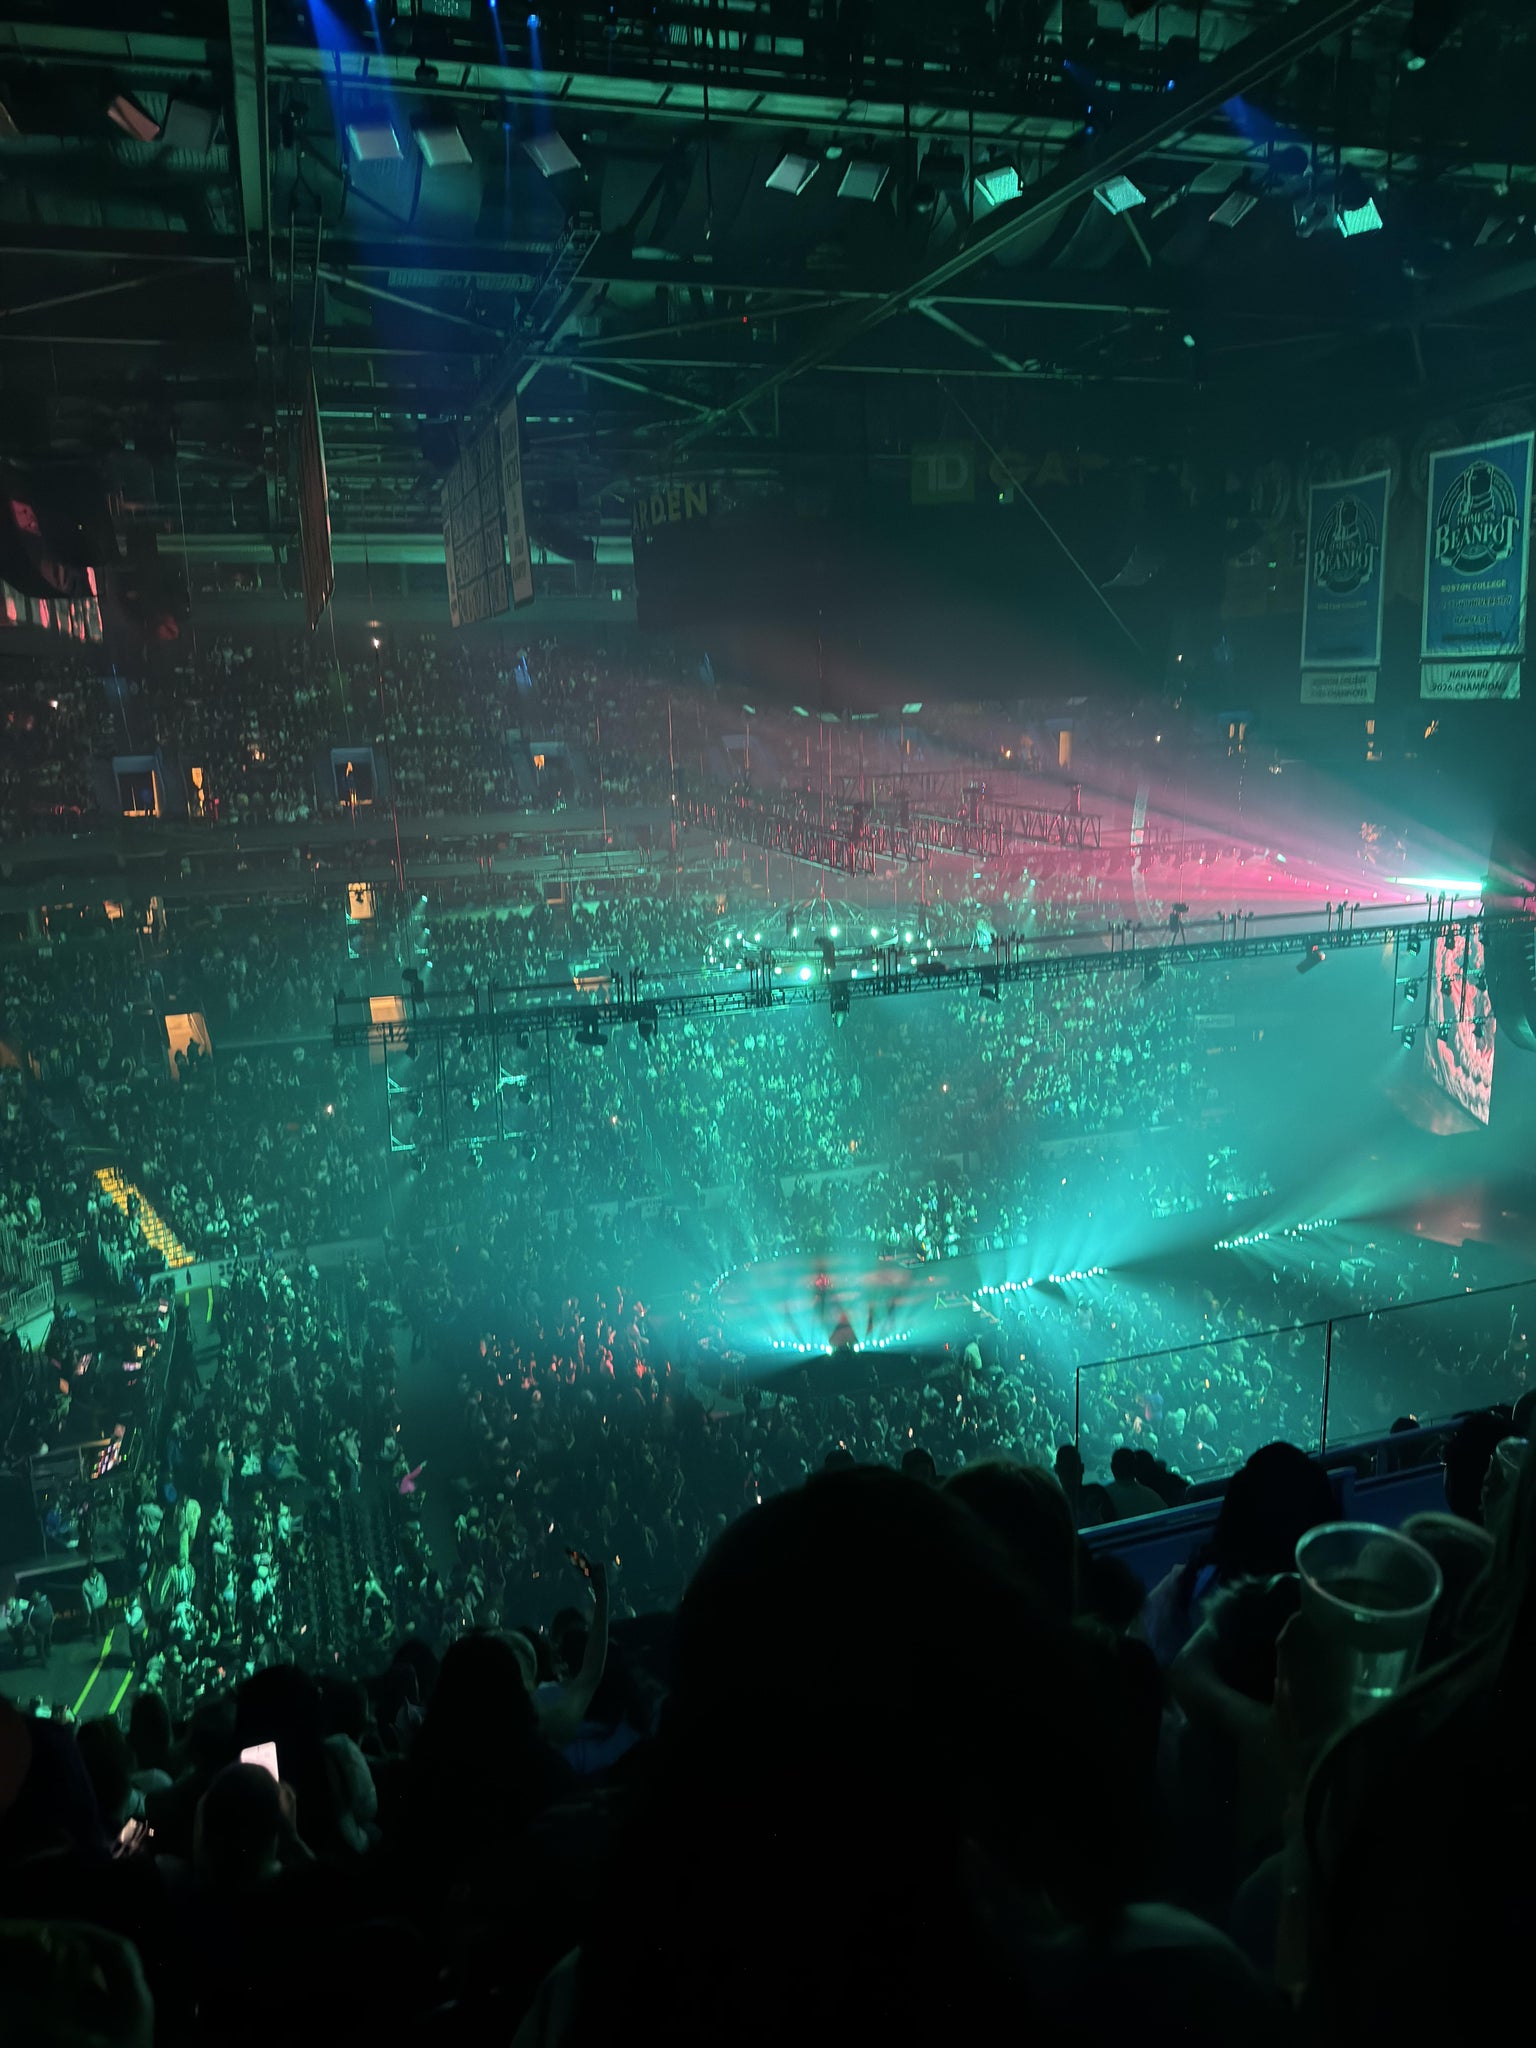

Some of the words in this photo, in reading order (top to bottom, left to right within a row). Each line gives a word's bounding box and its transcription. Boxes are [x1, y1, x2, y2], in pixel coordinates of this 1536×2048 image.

[914, 452, 969, 491] TD
[1435, 514, 1520, 560] BEANPOT
[1313, 542, 1379, 581] BEANPOT
[1431, 682, 1453, 693] 2026
[1449, 668, 1489, 679] HARVARD
